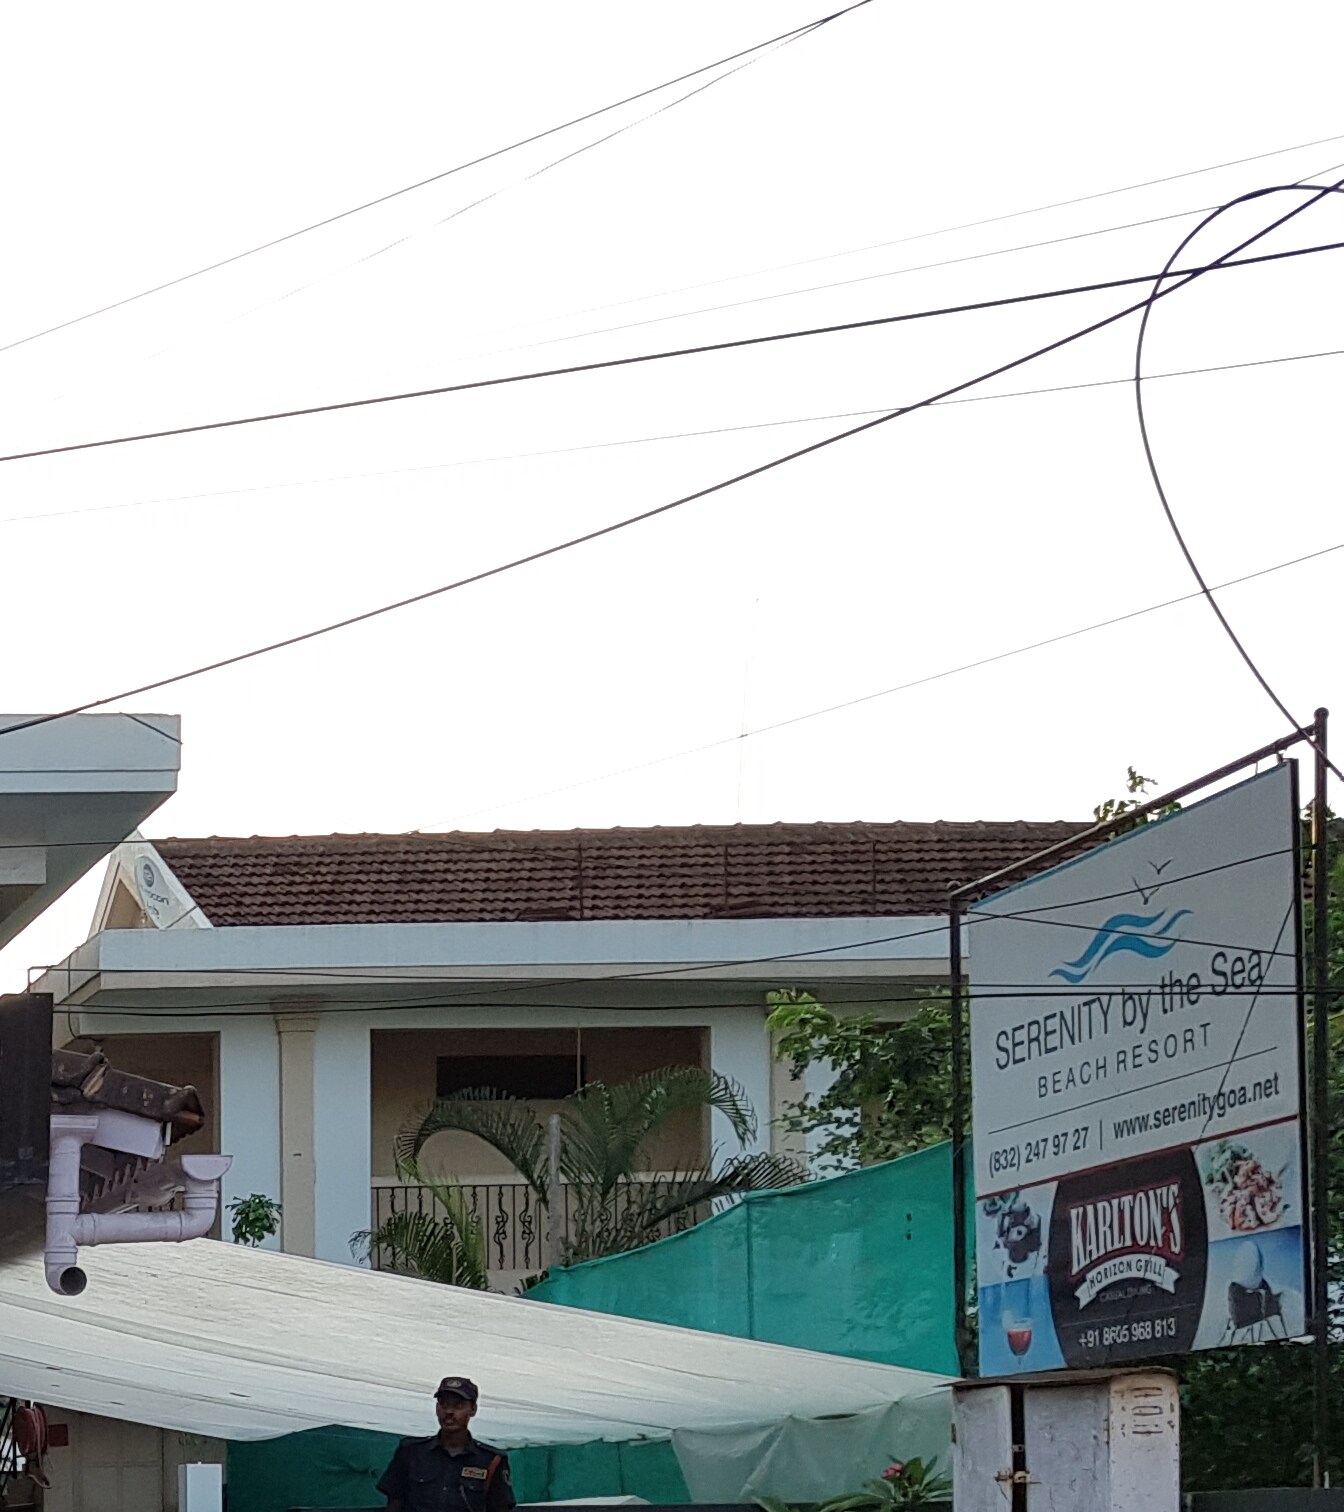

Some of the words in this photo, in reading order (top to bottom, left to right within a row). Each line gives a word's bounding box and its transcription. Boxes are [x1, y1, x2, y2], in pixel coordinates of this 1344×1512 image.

[995, 994, 1112, 1070] SERENITY
[1121, 987, 1151, 1034] by
[1161, 970, 1201, 1015] the
[1212, 950, 1263, 996] Sea
[1038, 1055, 1108, 1099] BEACH
[1116, 1022, 1211, 1075] RESORT
[989, 1145, 1021, 1178] (832)
[1025, 1138, 1049, 1164] 247
[1052, 1131, 1069, 1156] 97
[1073, 1126, 1089, 1151] 27
[1113, 1072, 1280, 1139] www.serenitygoa.net
[1070, 1183, 1181, 1276] KARLTON'S
[1089, 1259, 1132, 1287] HORIZON
[1136, 1258, 1163, 1277] GRILL
[1079, 1328, 1099, 1347] +91
[1132, 1321, 1152, 1341] 968
[1155, 1317, 1176, 1338] 813
